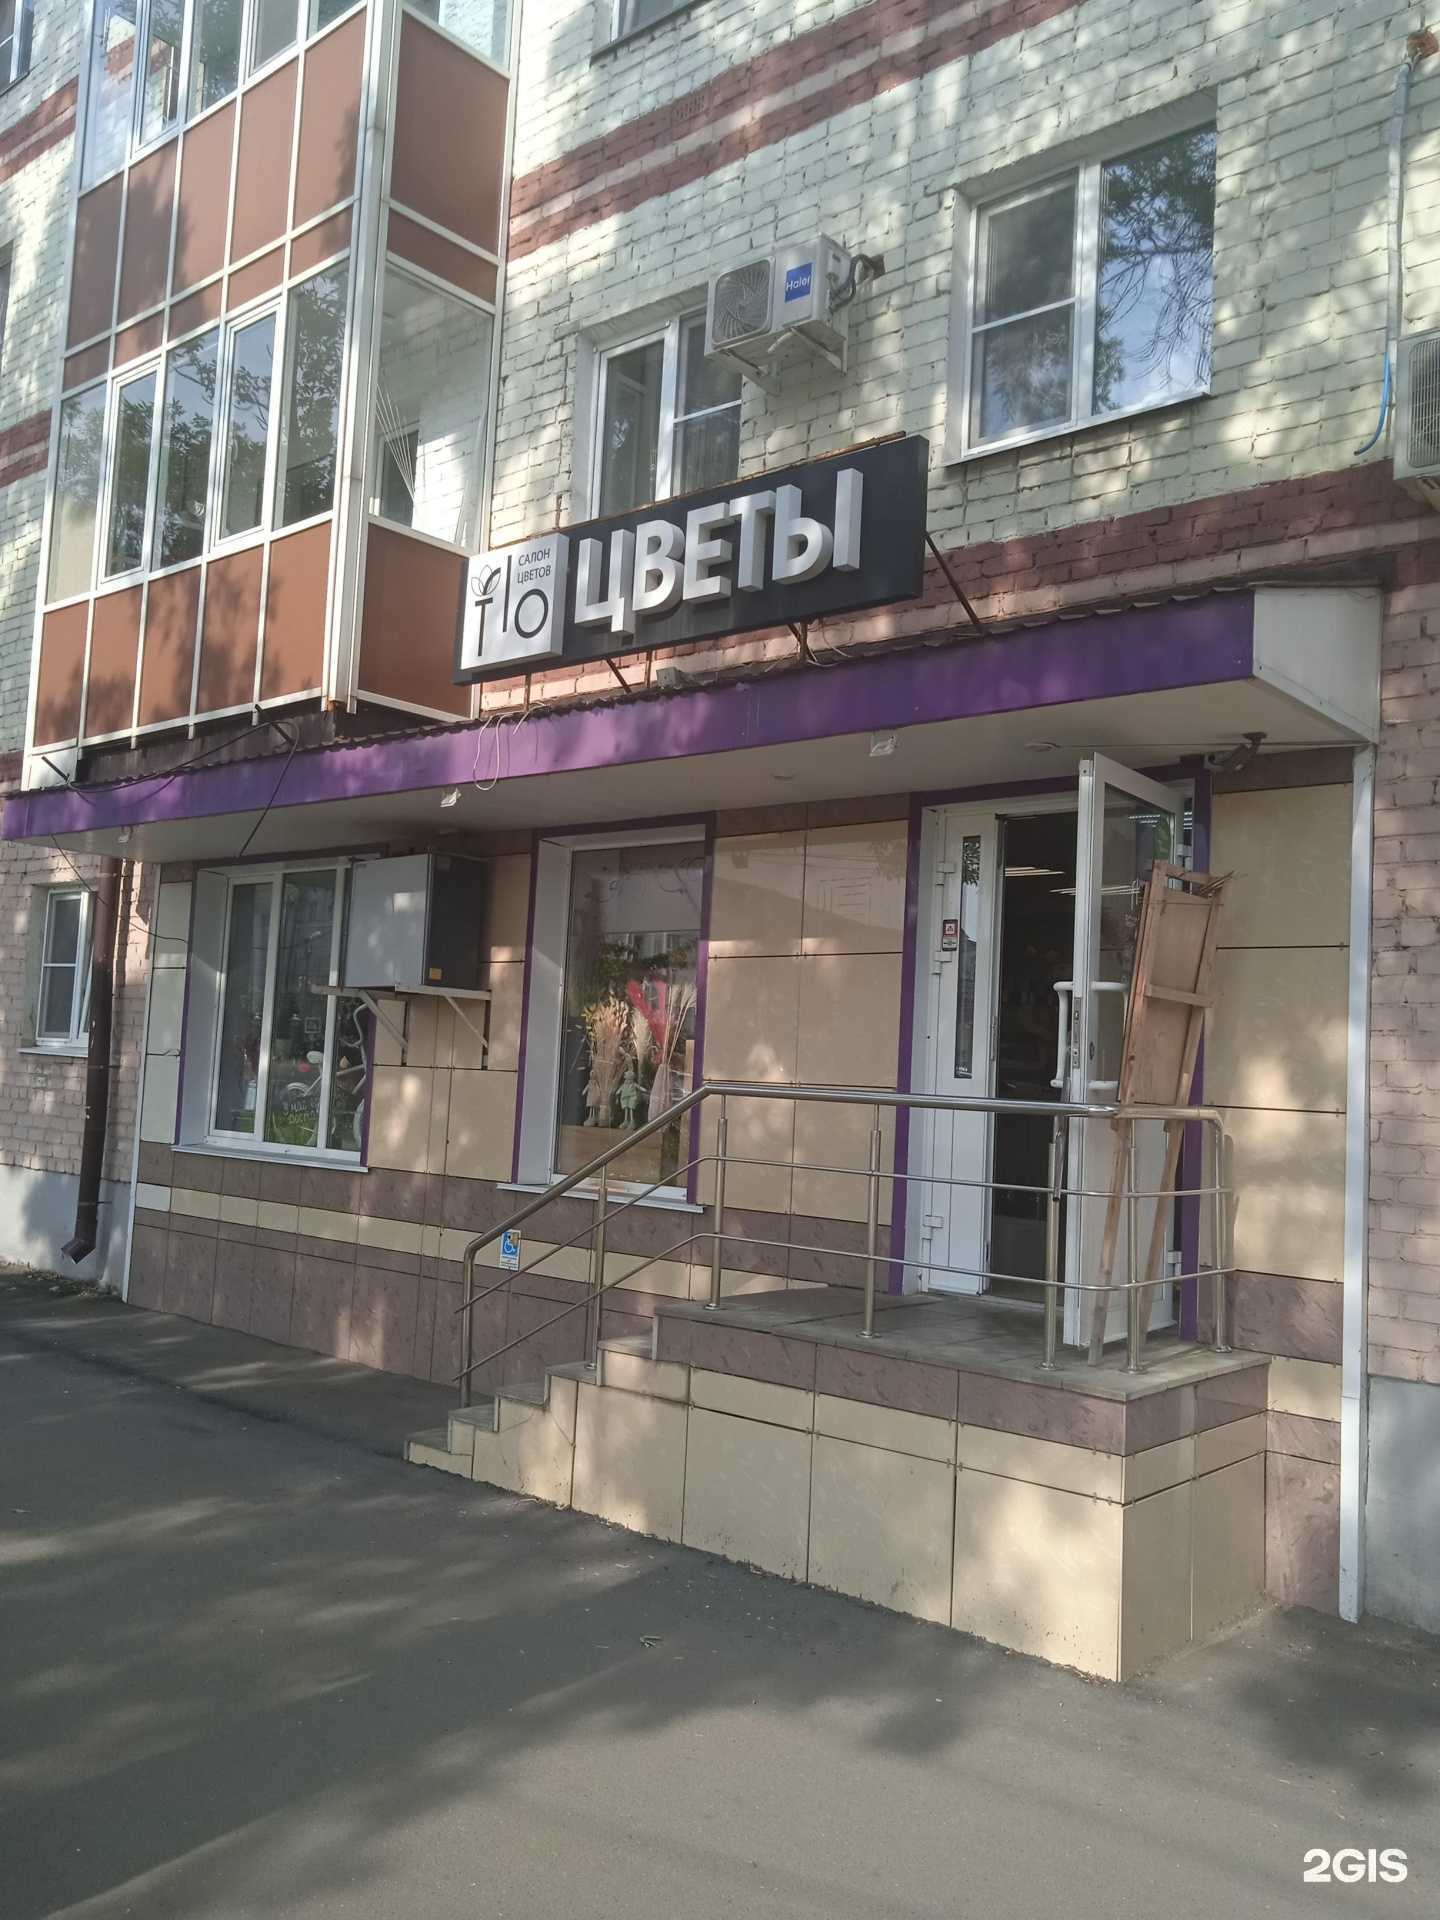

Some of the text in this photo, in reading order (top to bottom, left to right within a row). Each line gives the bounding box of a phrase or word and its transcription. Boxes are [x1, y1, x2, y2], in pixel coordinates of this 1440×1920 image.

[518, 548, 551, 566] САЛОН
[574, 468, 863, 635] ЦВЕТЫ
[517, 565, 551, 584] ЦВЕТОВ
